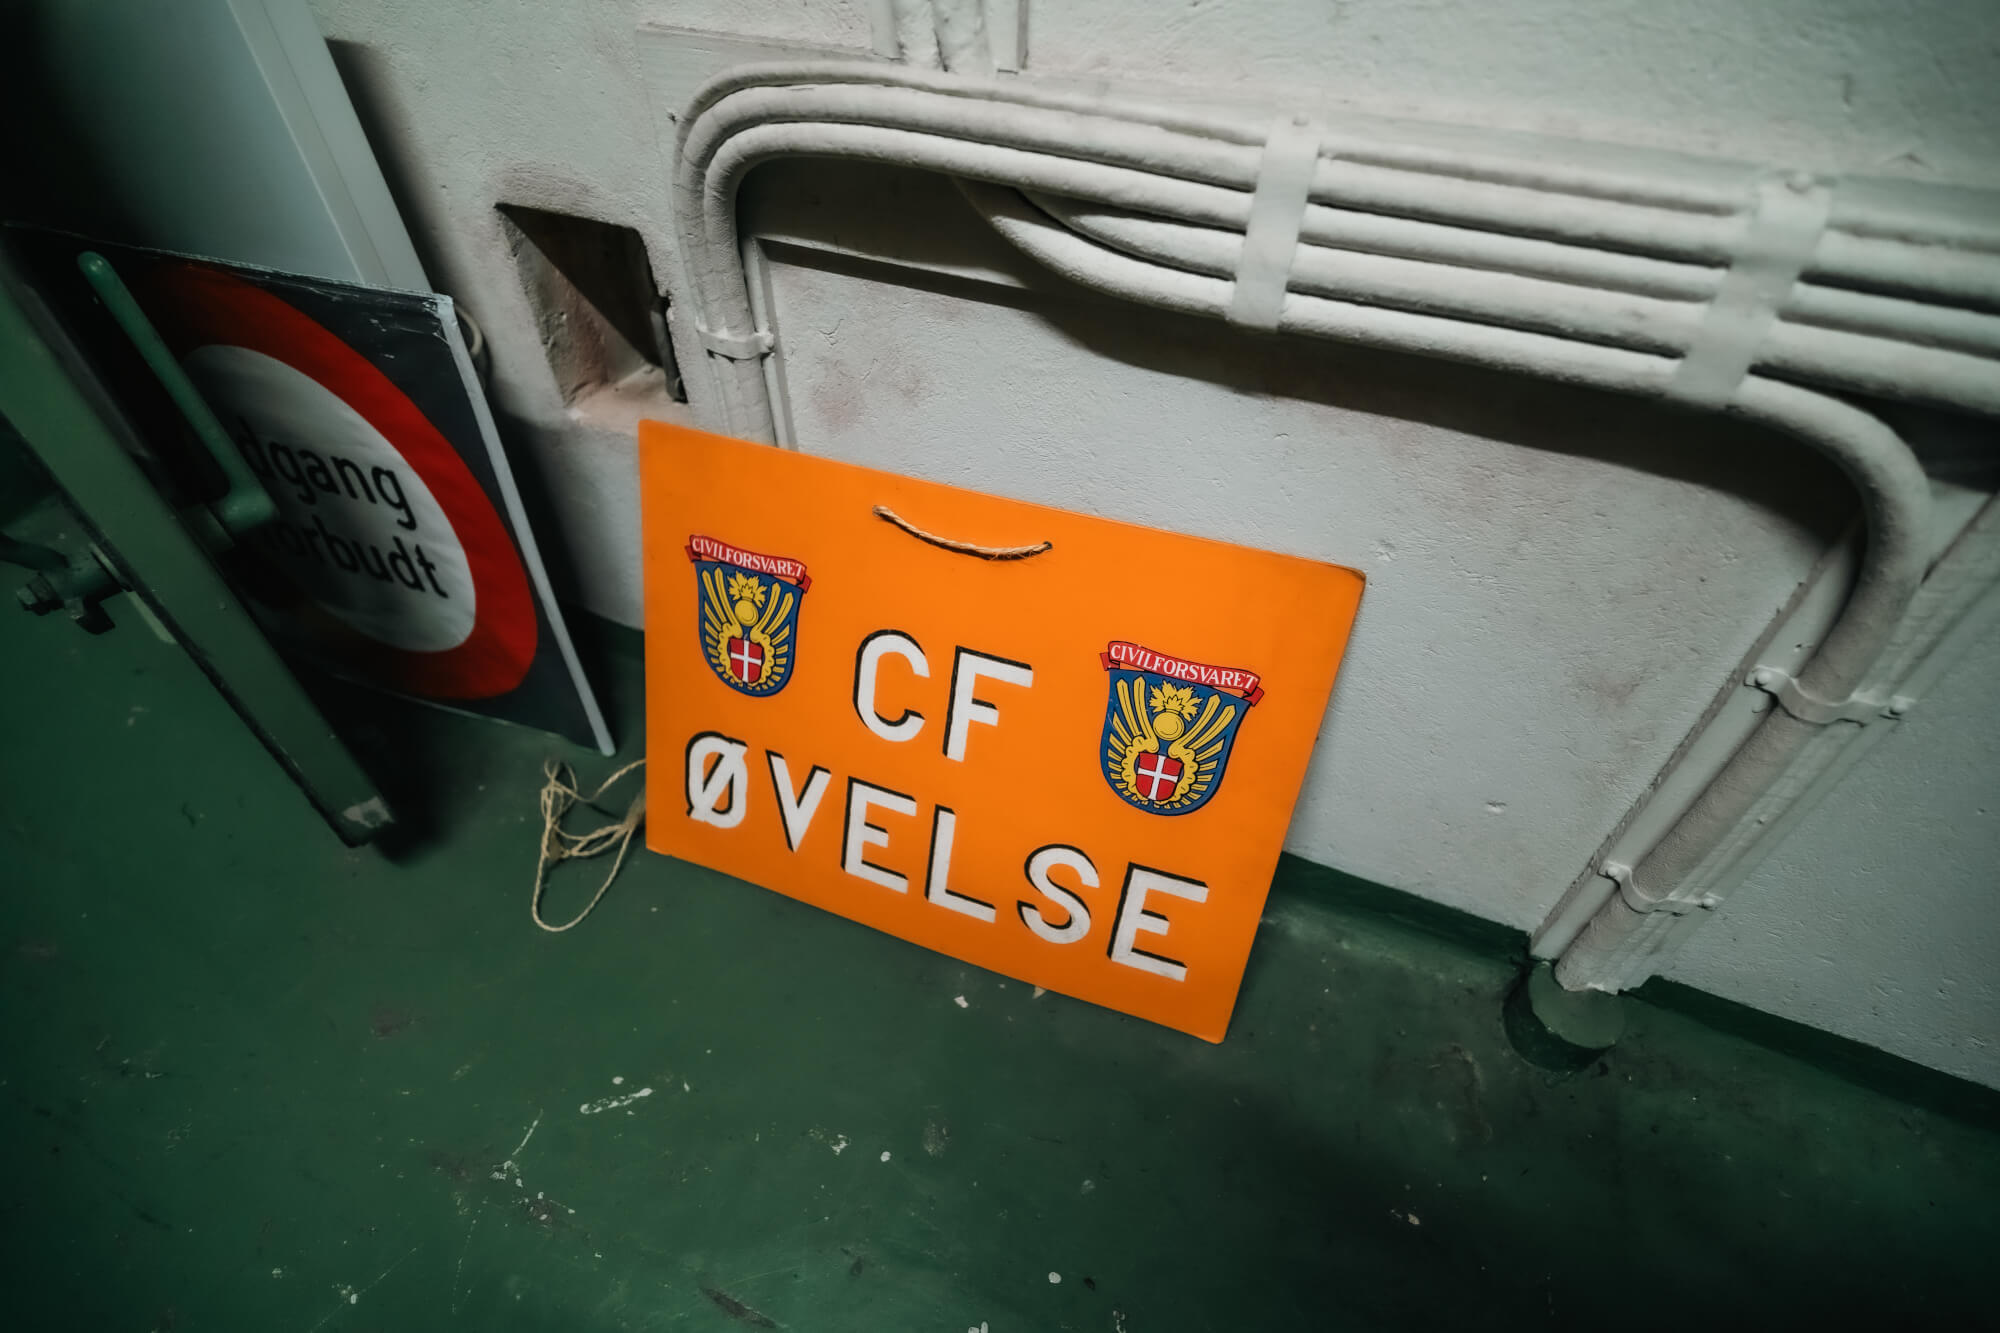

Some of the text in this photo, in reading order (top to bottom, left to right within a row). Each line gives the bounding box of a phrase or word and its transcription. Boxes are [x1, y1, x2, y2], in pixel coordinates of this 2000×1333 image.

[239, 416, 417, 531] dgang
[264, 514, 449, 599] orbudt
[692, 537, 806, 577] CIVILFORSVARET
[853, 629, 1033, 762] CF
[1110, 644, 1259, 690] CIVILFORSVARET
[685, 731, 1209, 982] ØVELSE
